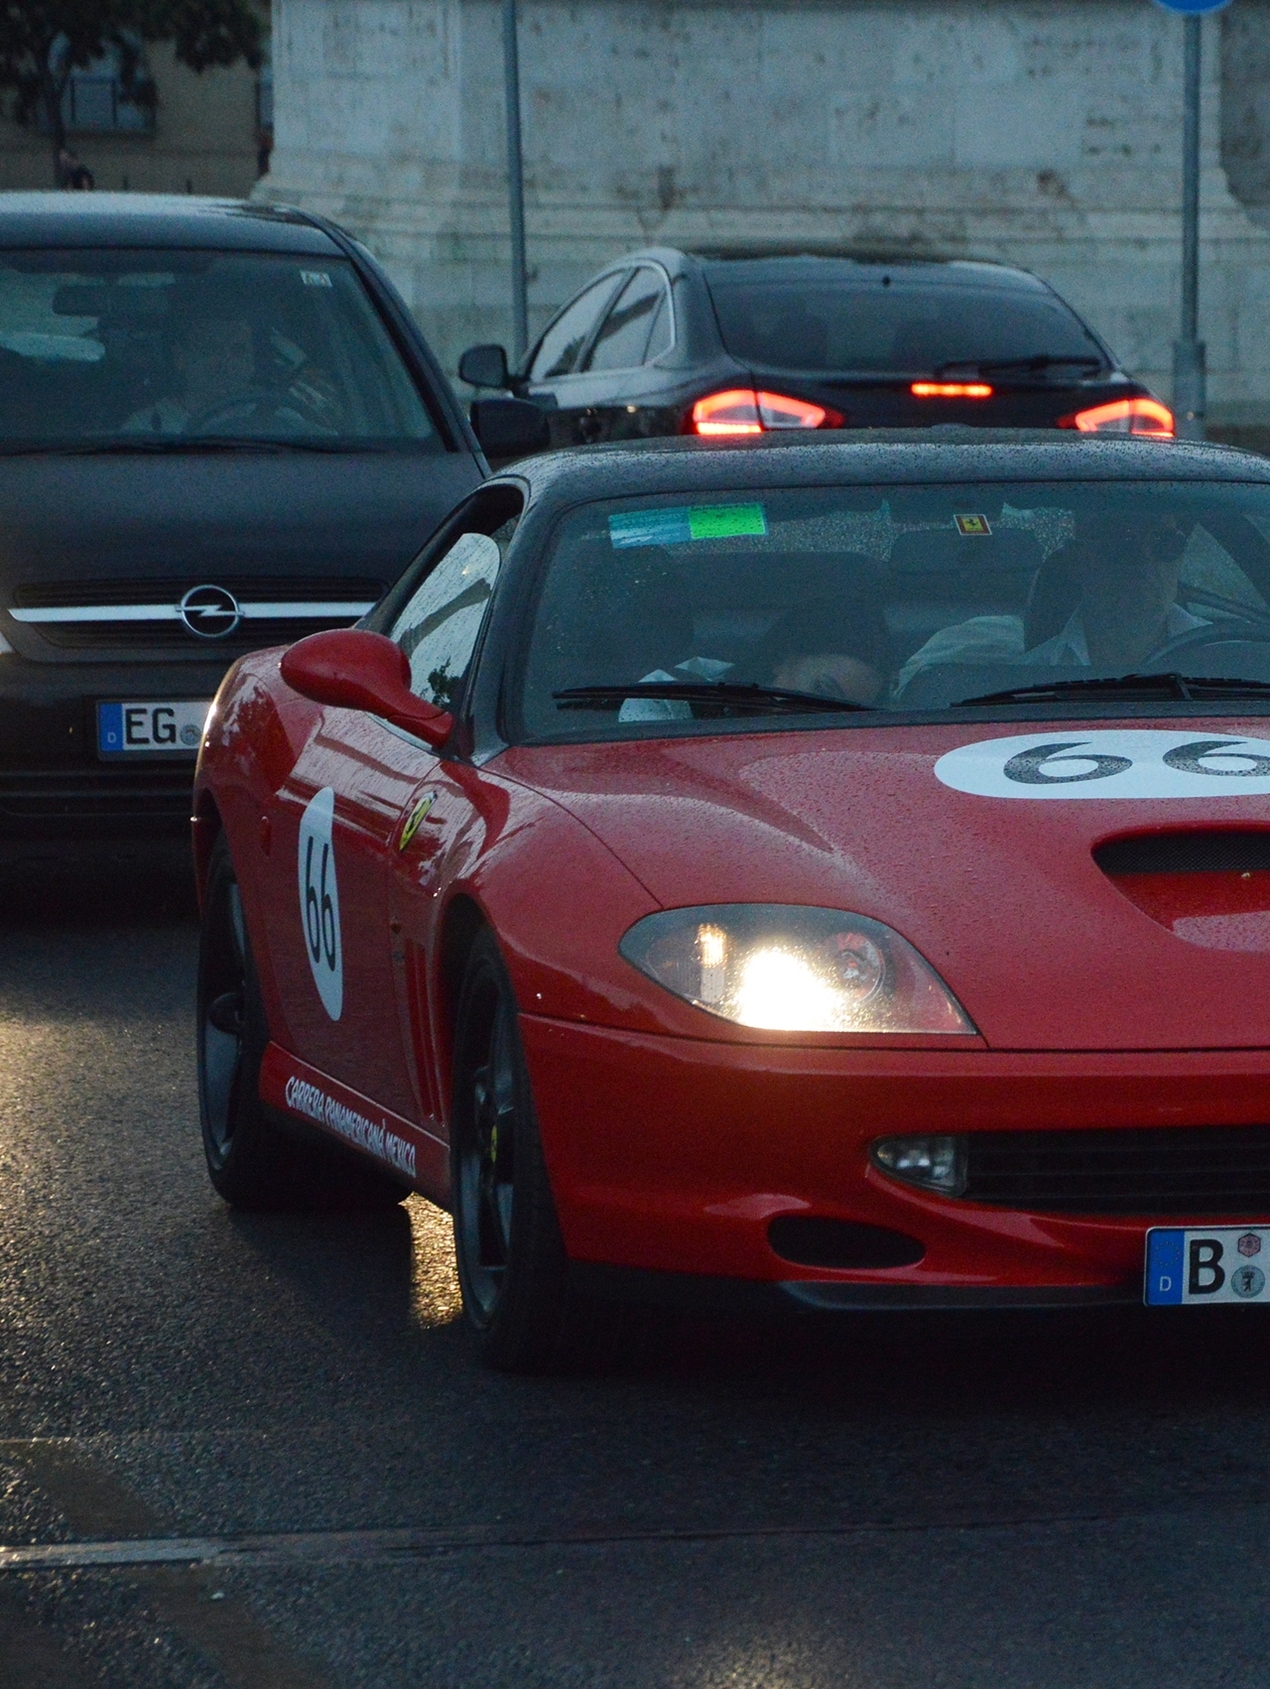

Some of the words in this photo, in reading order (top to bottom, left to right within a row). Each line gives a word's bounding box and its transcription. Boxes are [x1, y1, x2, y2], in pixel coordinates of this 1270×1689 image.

[126, 708, 176, 744] EG
[306, 836, 336, 972] 66
[285, 1075, 325, 1123] CARRERA
[385, 1131, 417, 1179] MEXICO
[1159, 1276, 1172, 1292] D
[1188, 1238, 1225, 1294] B
